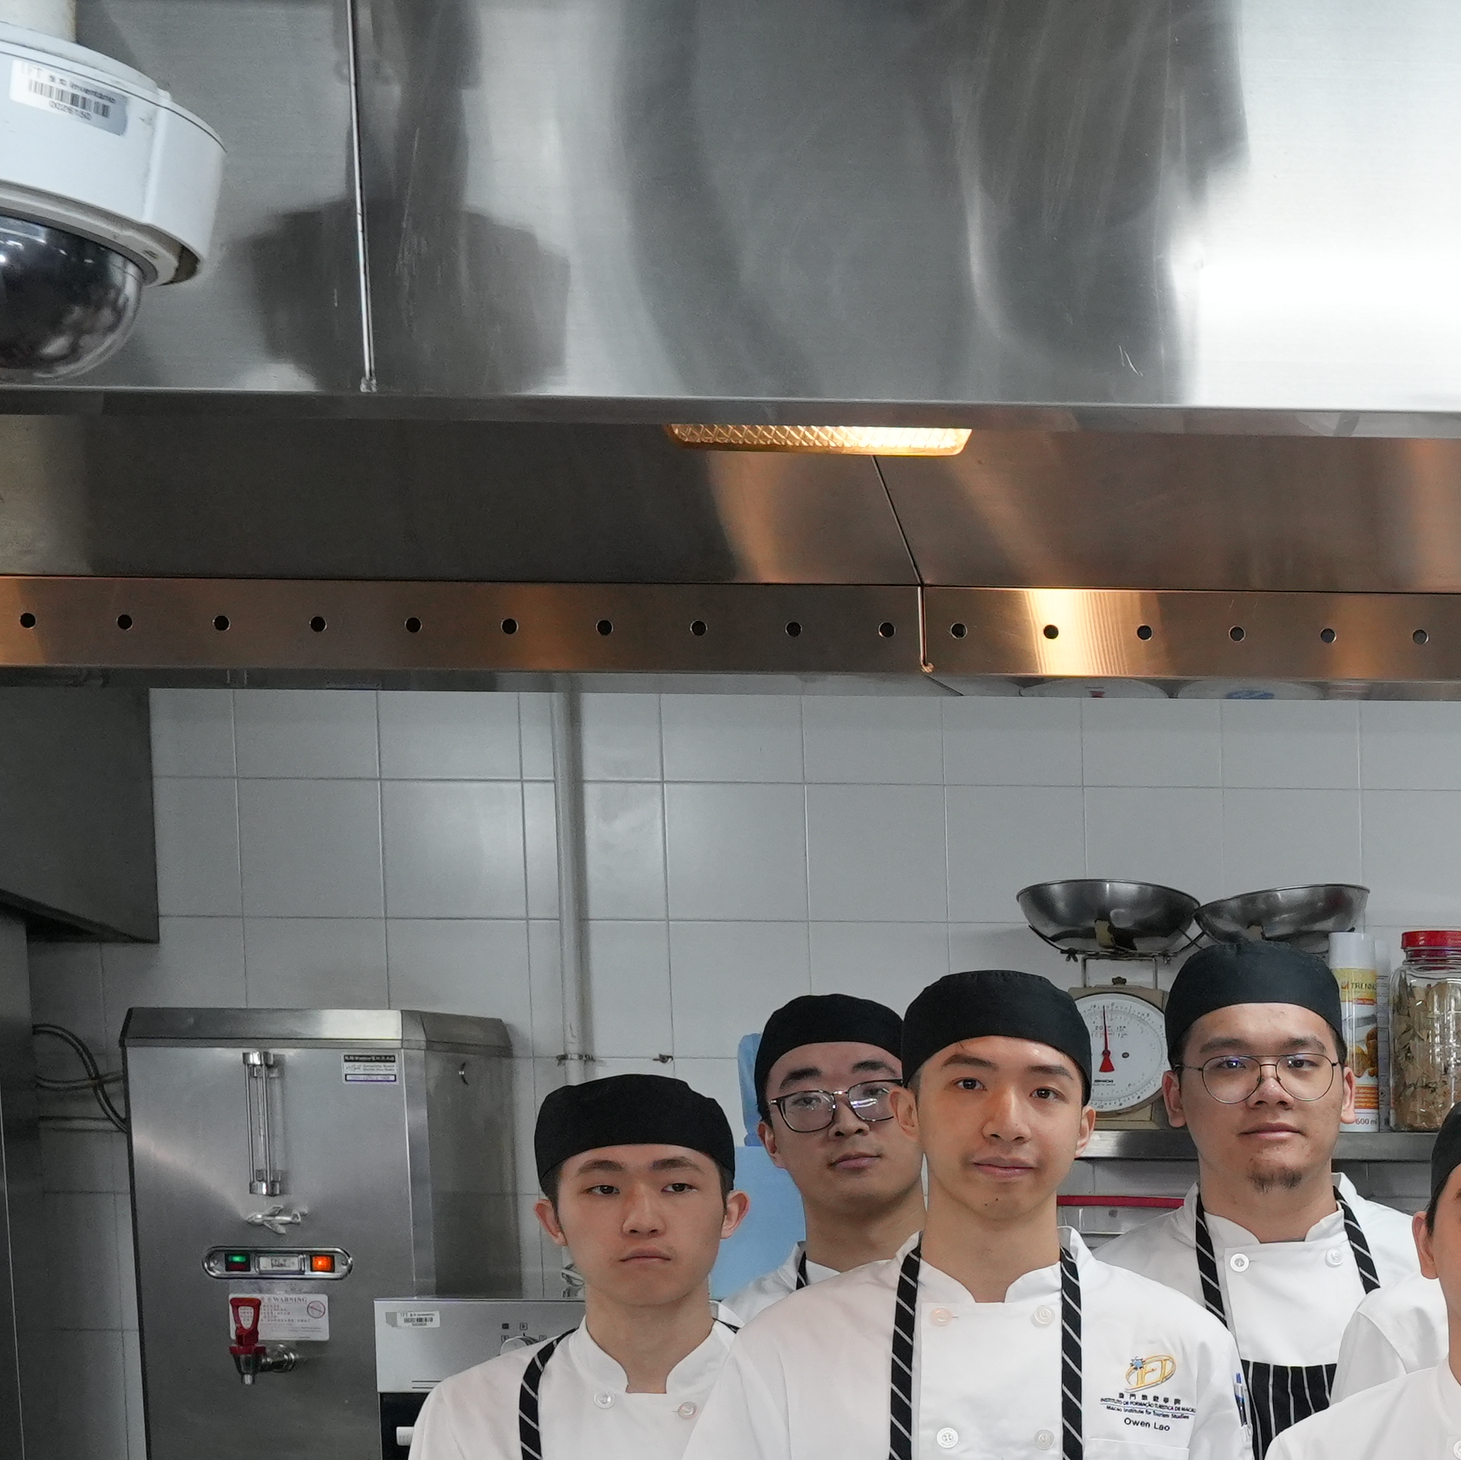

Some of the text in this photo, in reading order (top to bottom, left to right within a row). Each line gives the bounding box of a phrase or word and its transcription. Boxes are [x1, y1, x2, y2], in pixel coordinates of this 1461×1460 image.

[1355, 1117, 1370, 1125] 600
[1124, 1417, 1171, 1432] Owen Lao
